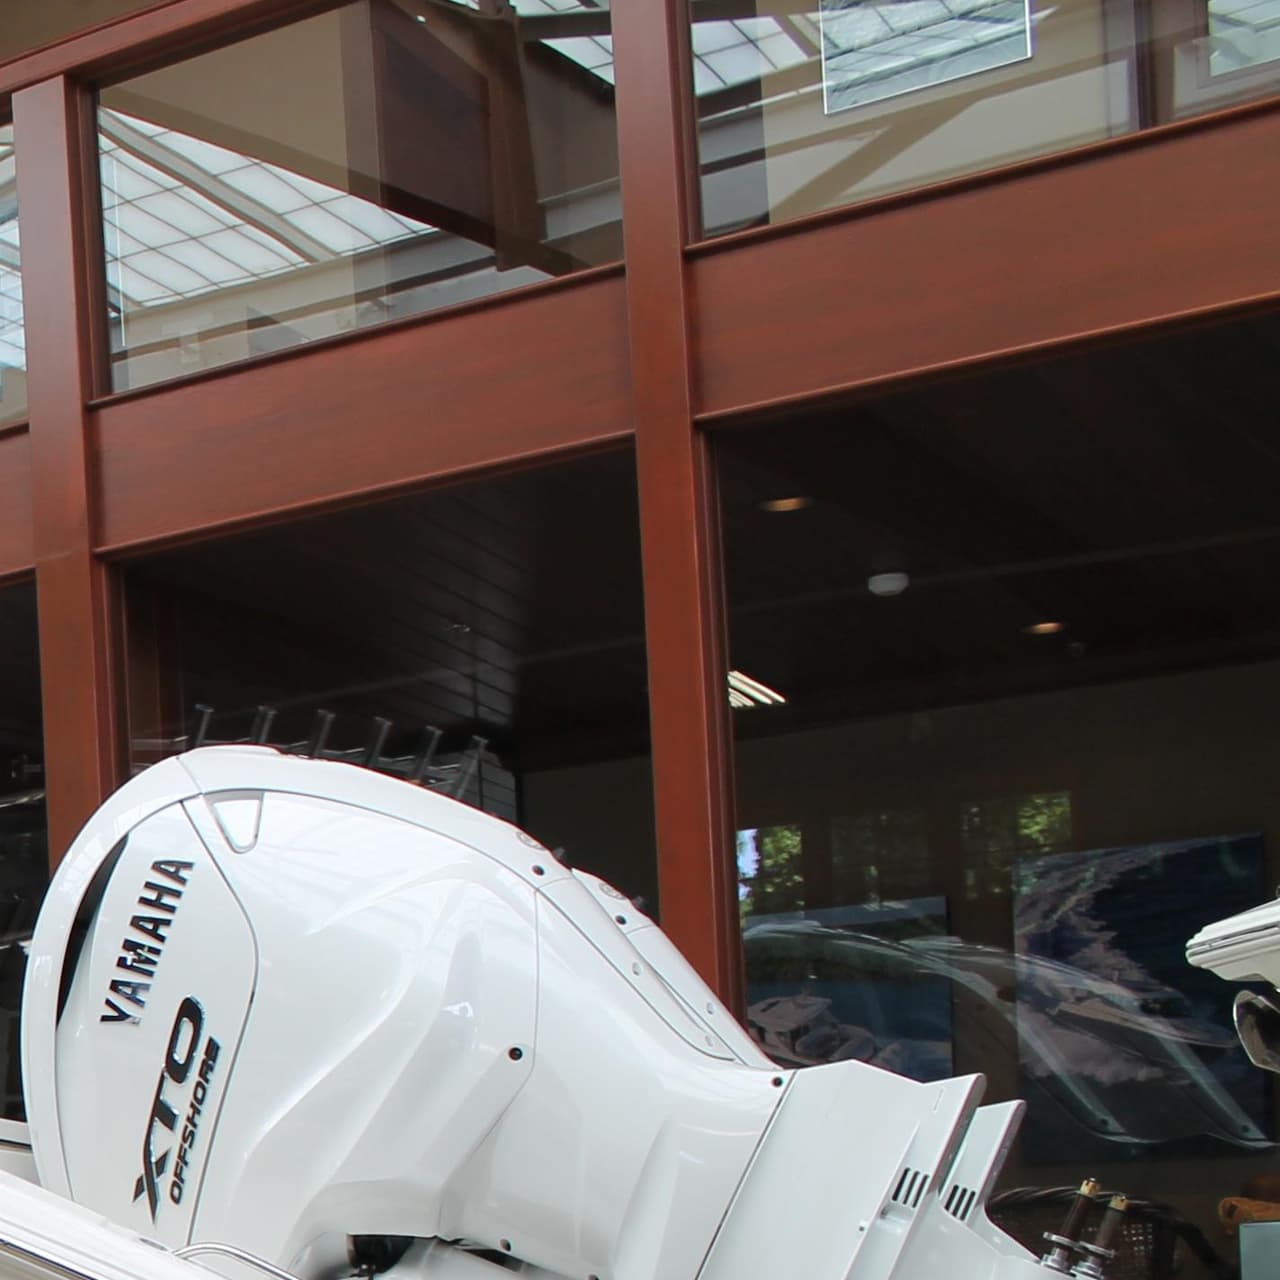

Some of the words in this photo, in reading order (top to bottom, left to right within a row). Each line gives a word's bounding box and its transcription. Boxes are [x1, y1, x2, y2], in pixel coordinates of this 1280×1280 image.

[99, 859, 196, 1026] YAMAHA
[132, 995, 206, 1225] XTO
[169, 1036, 221, 1204] OFFSHORE
